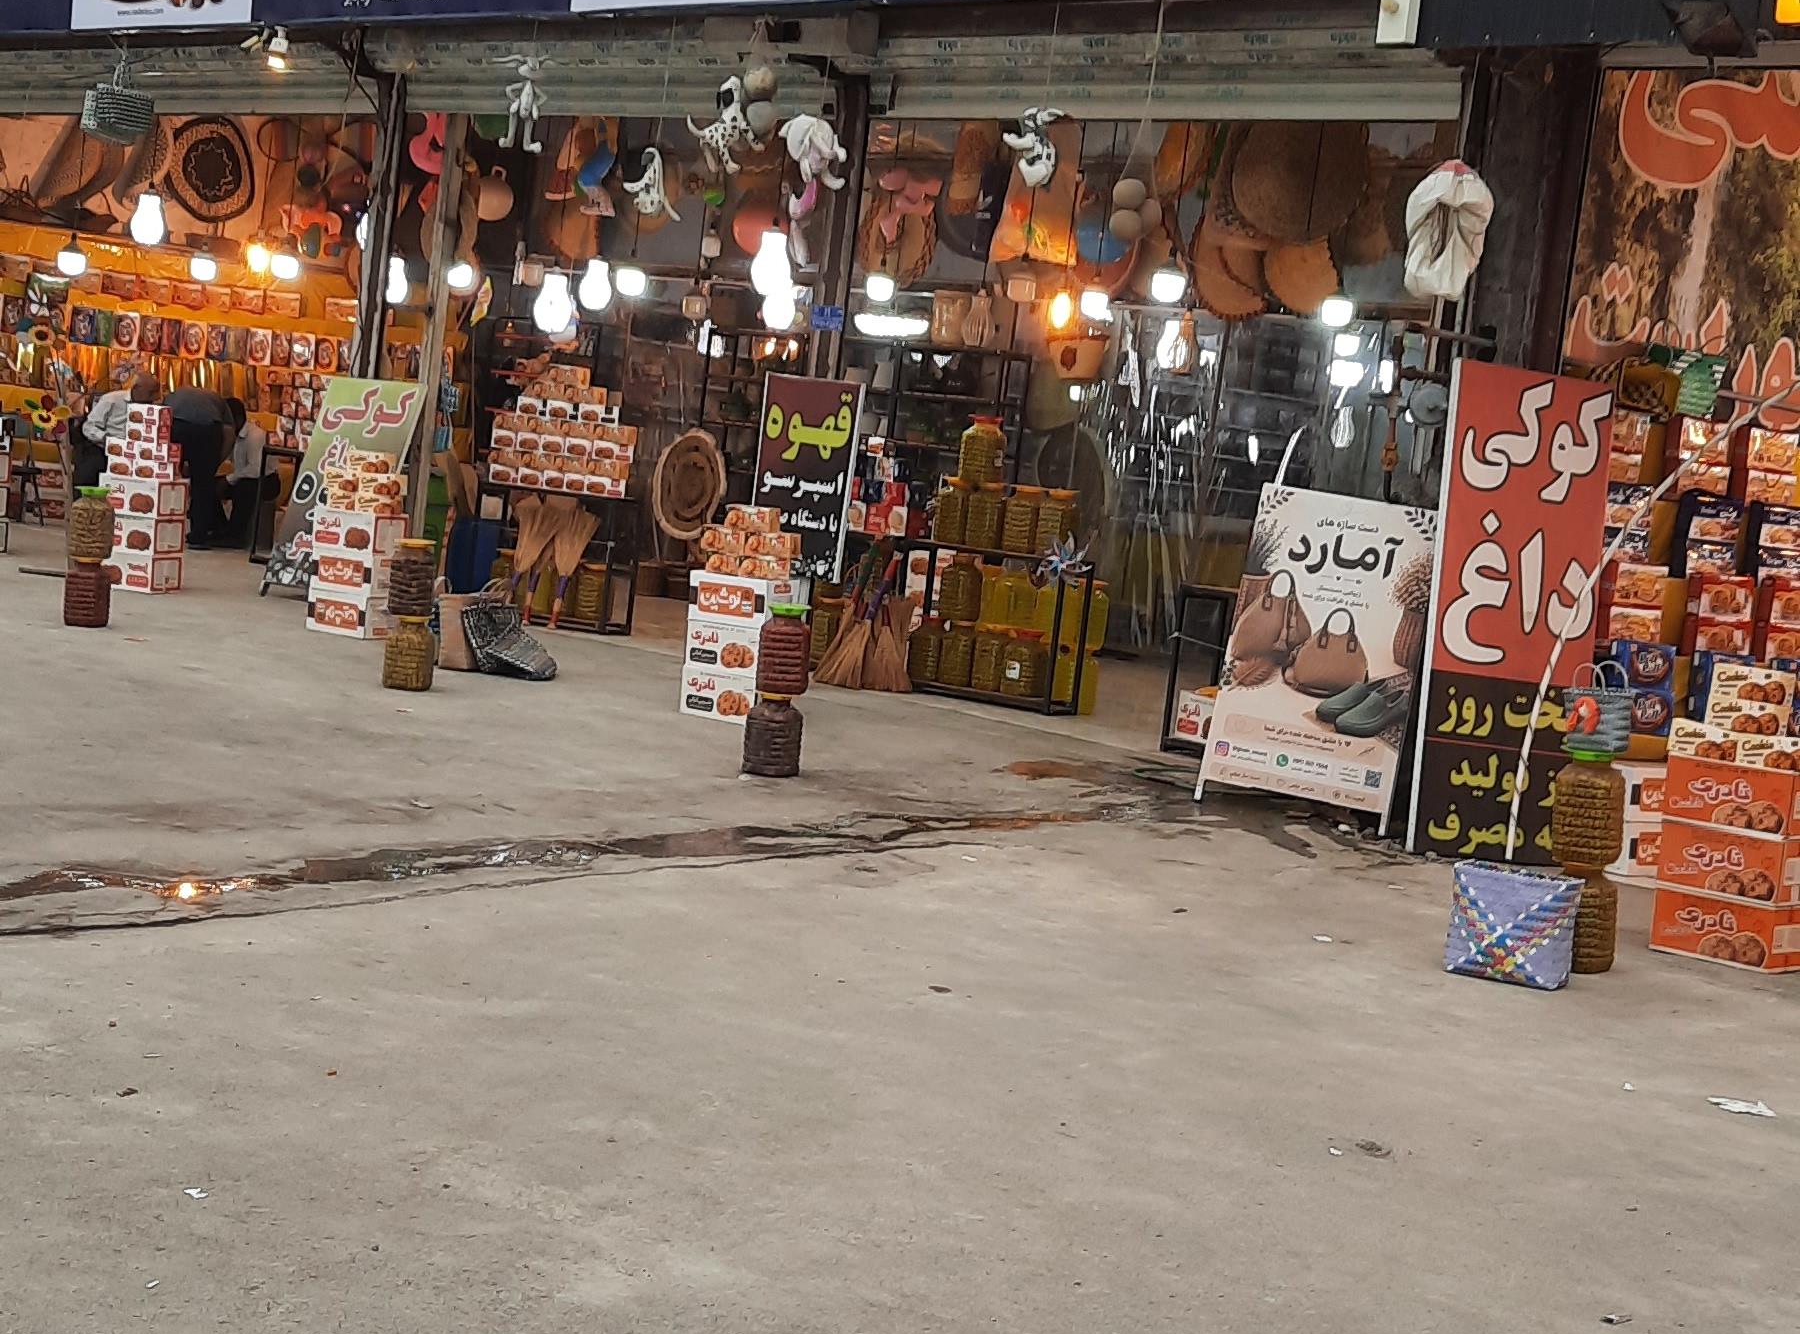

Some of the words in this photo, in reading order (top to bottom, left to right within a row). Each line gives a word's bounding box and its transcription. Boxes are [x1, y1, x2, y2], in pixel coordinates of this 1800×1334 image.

[322, 387, 417, 436] کوکی
[765, 392, 854, 461] قهوه
[1460, 380, 1613, 503] کوکی
[760, 470, 844, 503] اسپرسو
[790, 507, 827, 531] دستگاه
[829, 516, 838, 538] با
[1288, 533, 1405, 580] آمارد
[1441, 511, 1595, 665] داغ
[690, 629, 719, 646] نادری
[687, 676, 716, 693] نادری
[1437, 686, 1494, 737] روز
[1688, 777, 1753, 804] نادری
[1683, 843, 1744, 870] نادری
[1675, 907, 1738, 934] نادری
